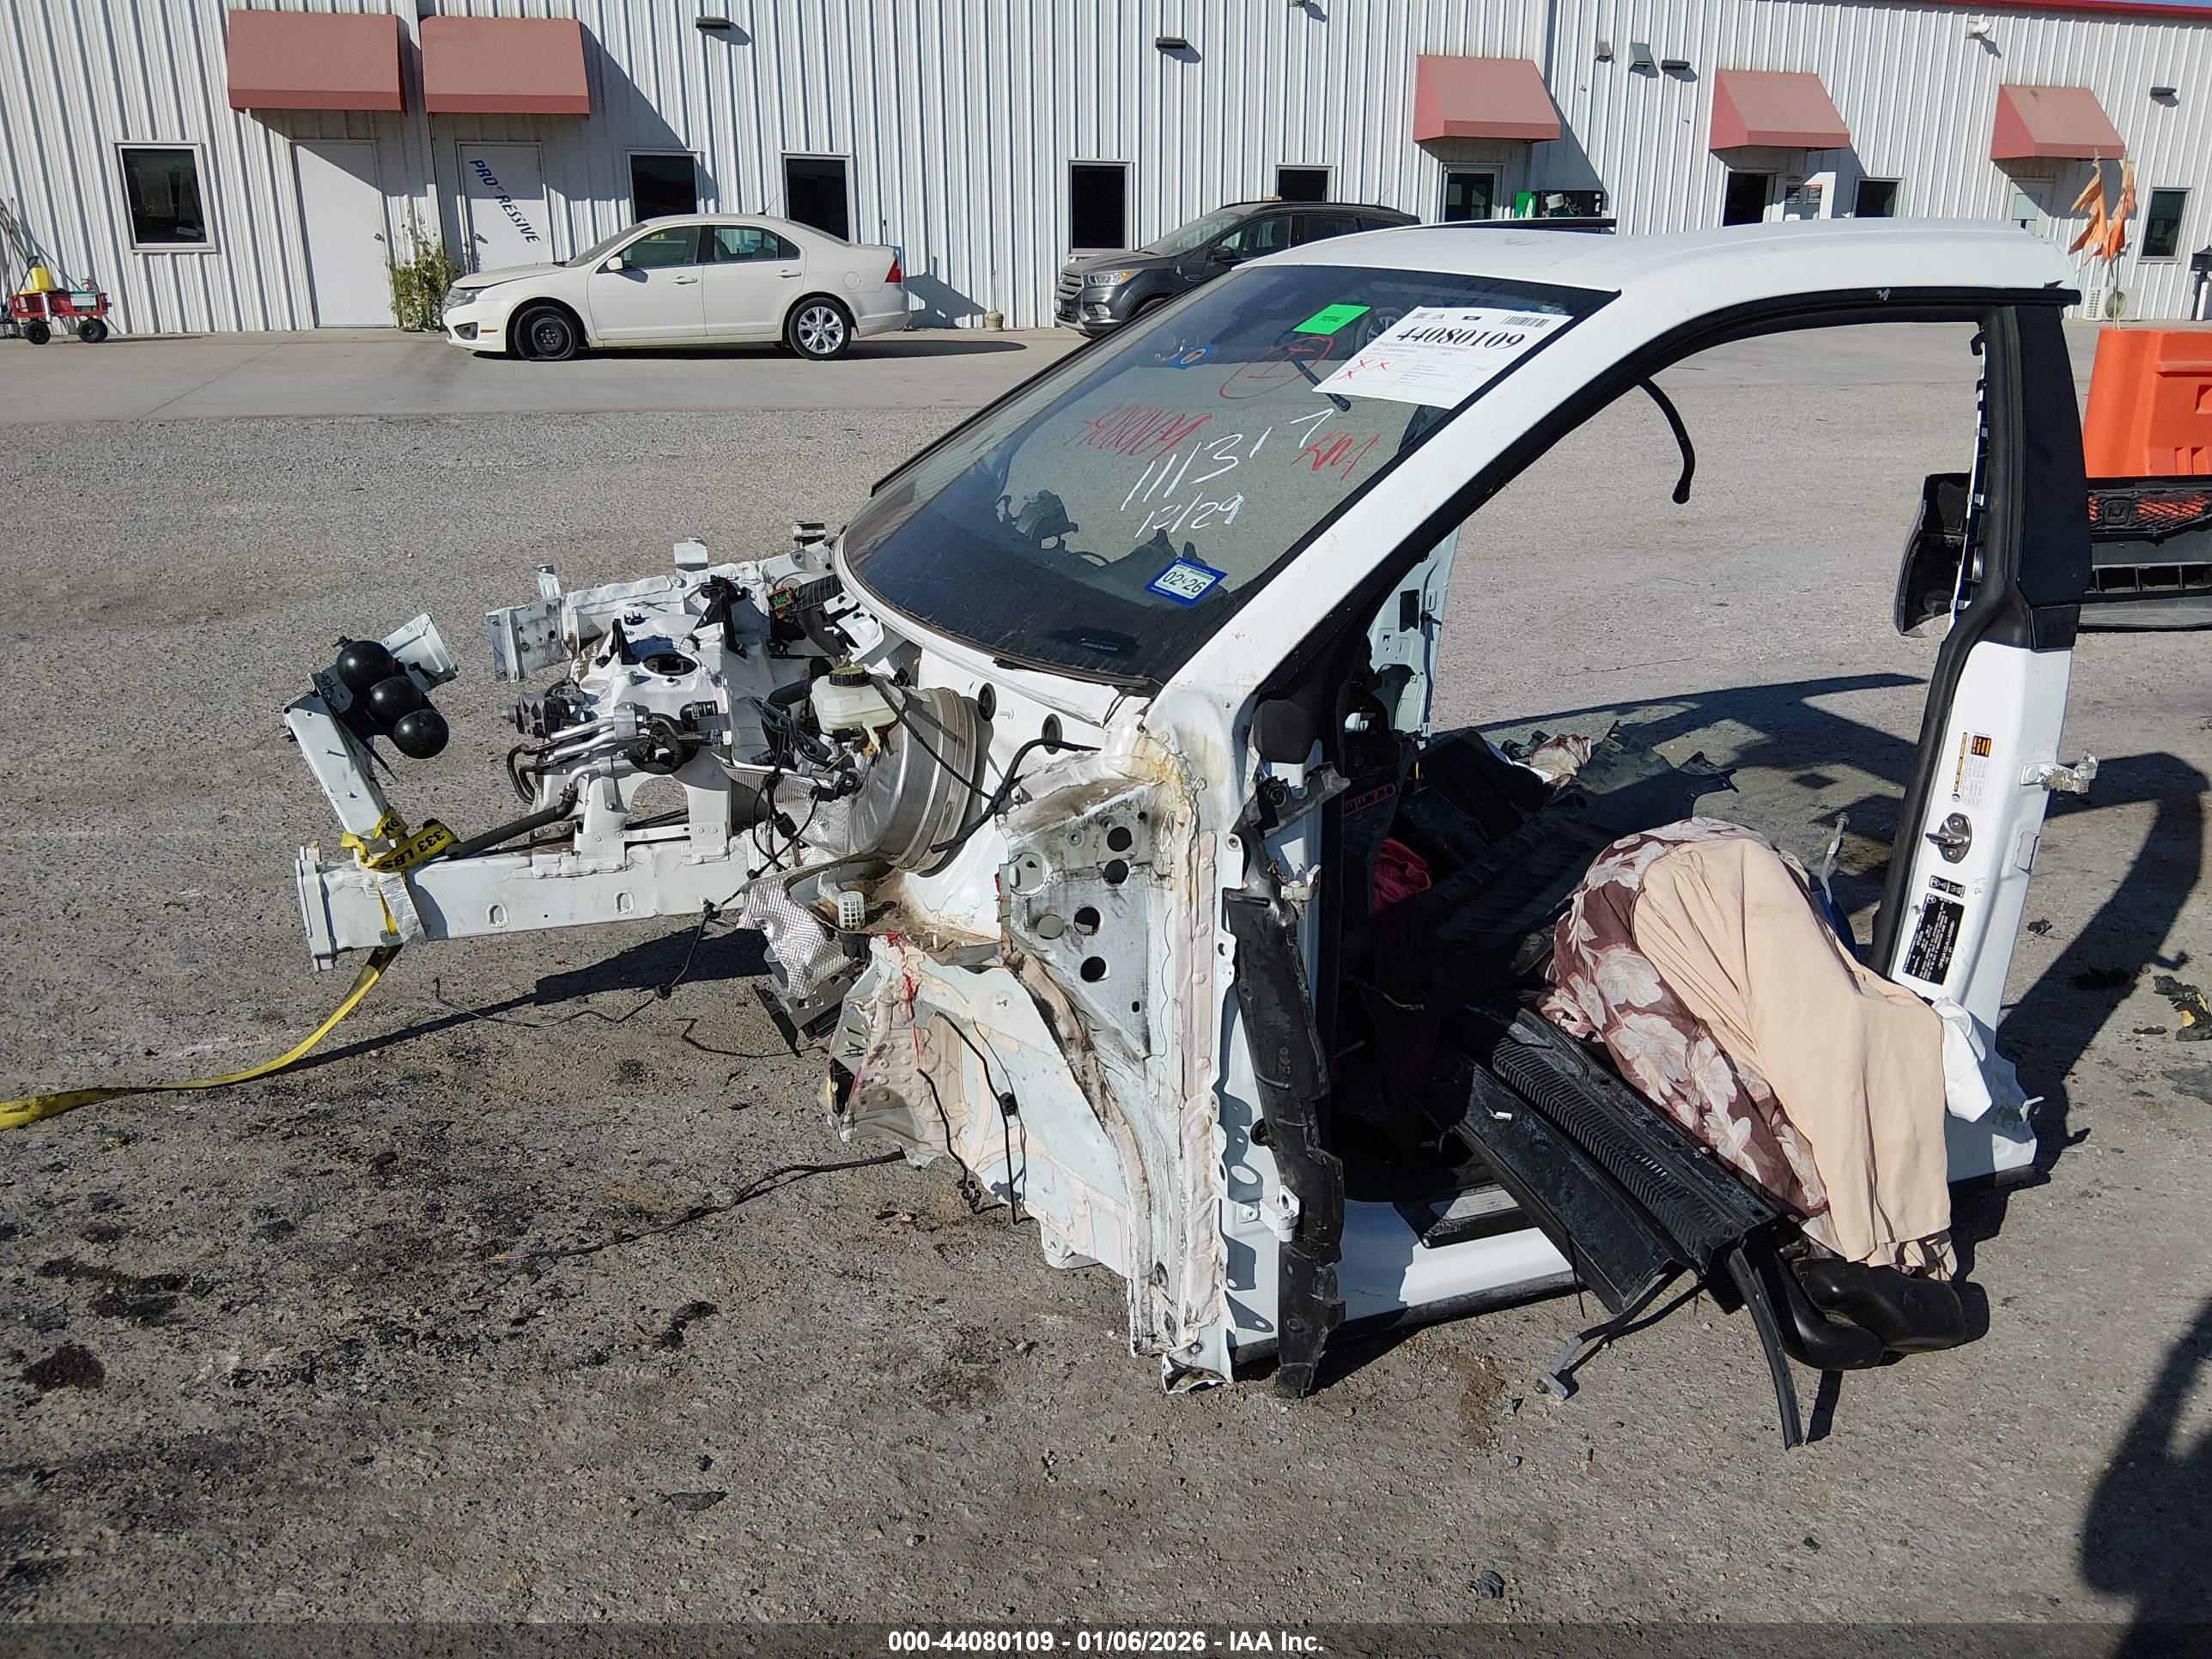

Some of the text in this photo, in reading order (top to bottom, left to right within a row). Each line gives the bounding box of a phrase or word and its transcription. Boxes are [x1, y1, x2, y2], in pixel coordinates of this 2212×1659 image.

[1319, 314, 1343, 323] TOTAL
[1395, 325, 1526, 349] 44080109
[1438, 344, 1470, 353] Insurance
[1134, 492, 1246, 539] 12/29
[1163, 571, 1183, 586] 02
[1182, 578, 1206, 593] 26
[380, 847, 416, 870] LBS
